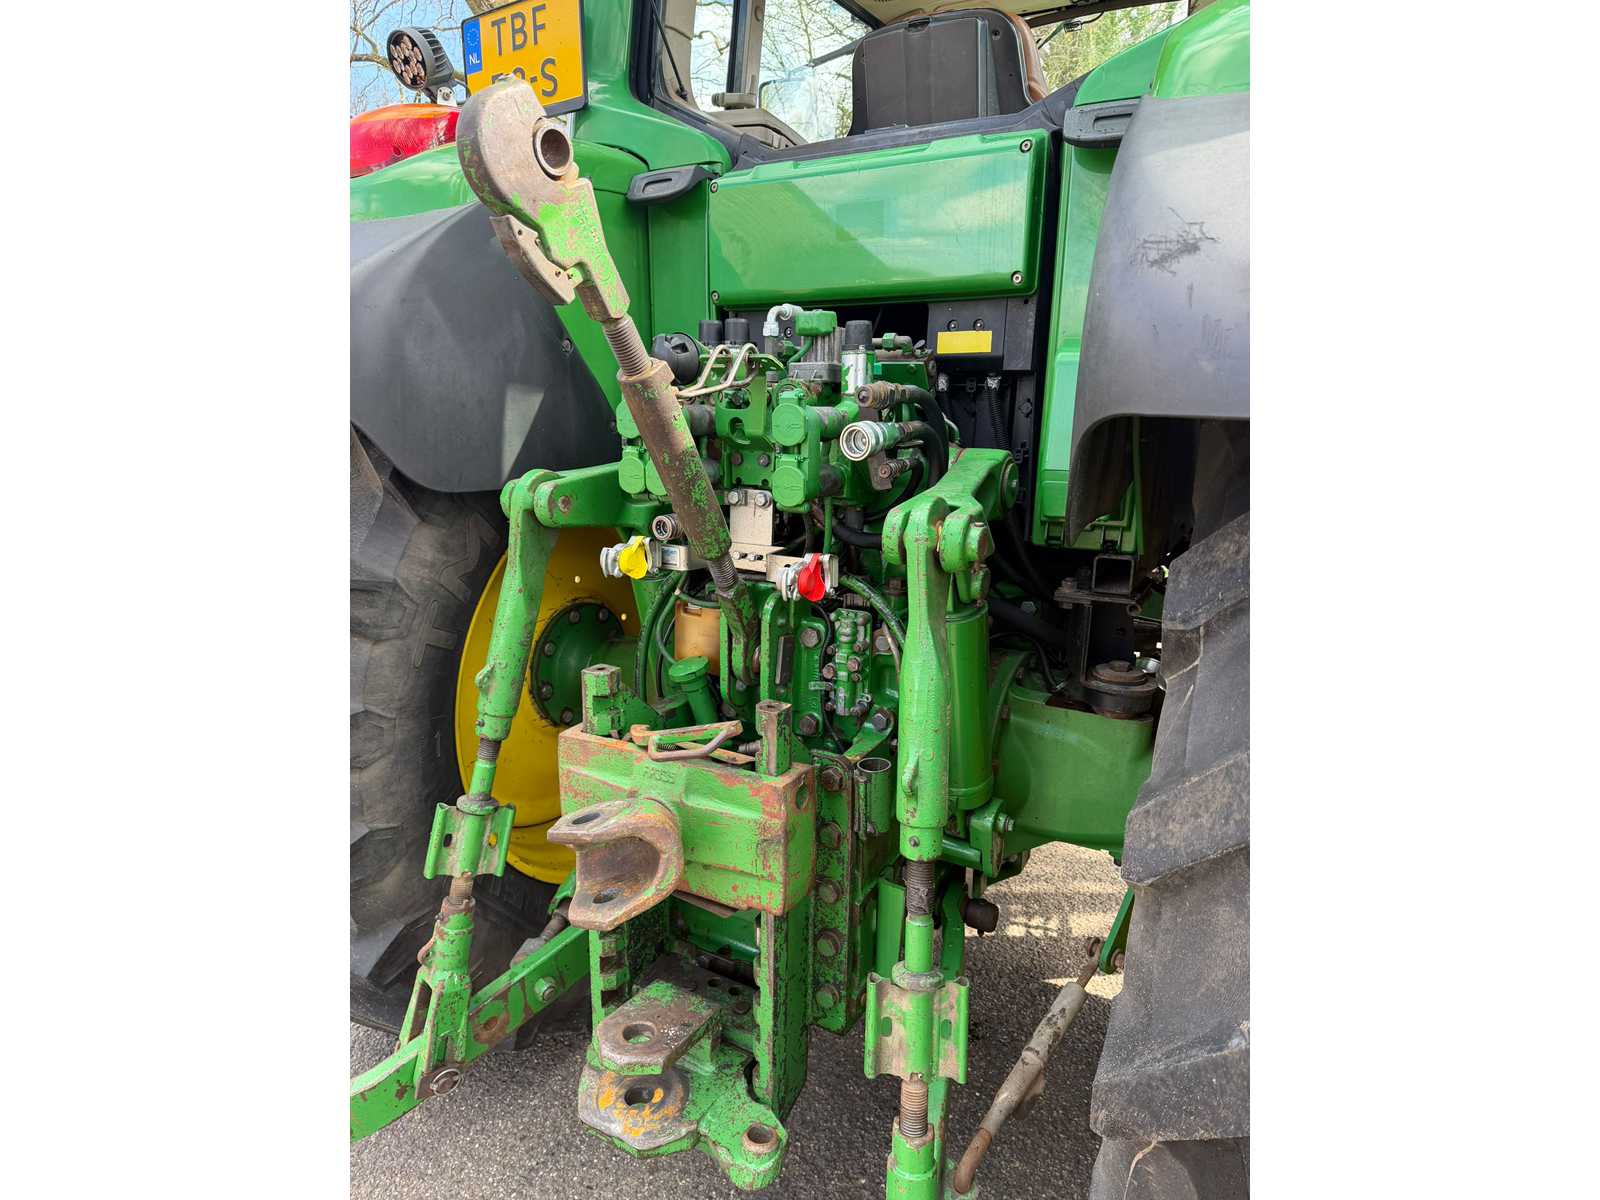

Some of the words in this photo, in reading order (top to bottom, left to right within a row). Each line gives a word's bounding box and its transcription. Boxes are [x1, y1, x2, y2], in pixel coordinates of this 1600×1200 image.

[491, 4, 546, 56] TBF
[469, 52, 480, 65] NL
[491, 57, 558, 97] -S
